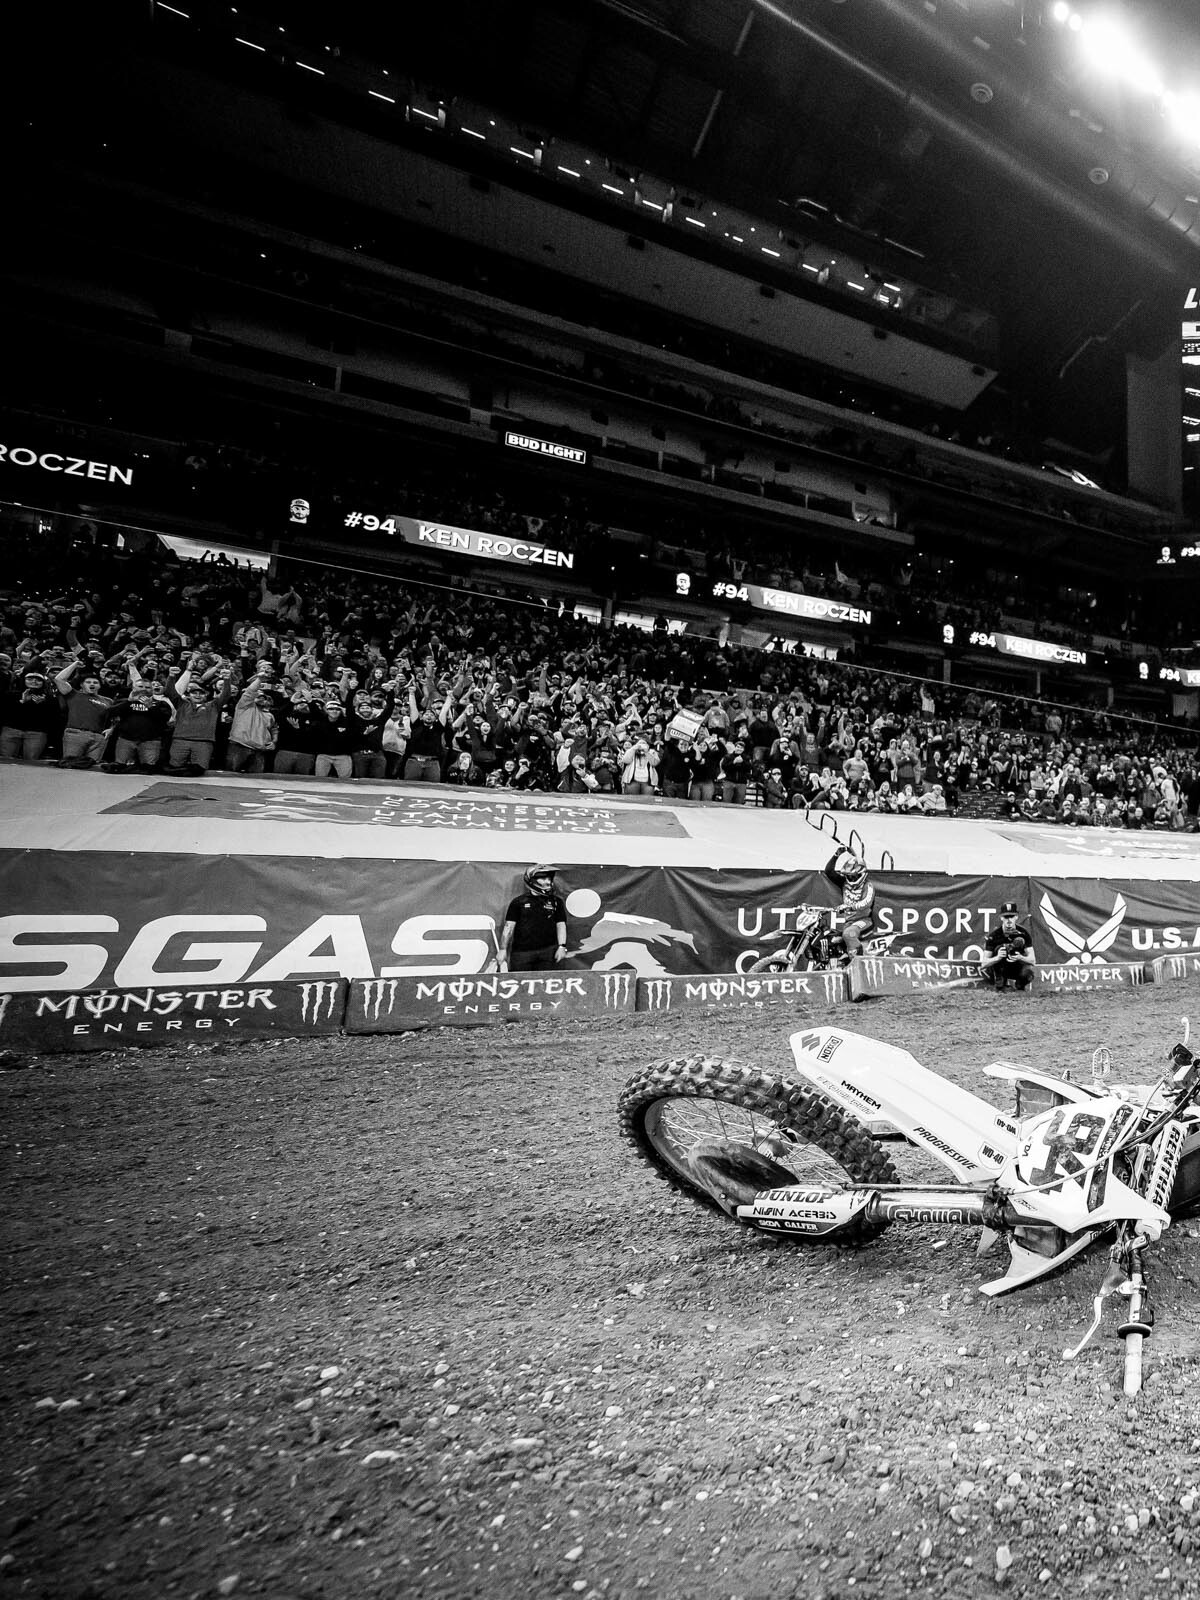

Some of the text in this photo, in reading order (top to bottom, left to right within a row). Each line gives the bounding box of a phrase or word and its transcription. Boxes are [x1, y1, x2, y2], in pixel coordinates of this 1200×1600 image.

[508, 434, 583, 461] BUD LIGHT
[344, 511, 574, 569] #94 KEN ROCZEN
[712, 582, 872, 625] #94 KEN ROCZEN
[969, 631, 1087, 664] #94 KEN ROCZEN
[1159, 668, 1181, 682] #94
[878, 907, 996, 934] SPORT
[1131, 929, 1190, 950] U.S.
[0, 915, 498, 991] SGAS
[893, 961, 991, 978] MONSTER
[1040, 966, 1124, 983] MONSTER
[415, 977, 587, 1002] MONSTER
[685, 977, 813, 1001] MONSTER
[35, 988, 278, 1019] MONSTER
[443, 1001, 562, 1014] ENERGY
[72, 1018, 241, 1035] ENERGY
[841, 1080, 882, 1110] MAYHEM
[996, 1118, 1017, 1135] WD-40
[913, 1126, 978, 1171] PROGRESSIVE
[982, 1145, 1005, 1165] WD-40
[1152, 1124, 1181, 1207] RENTHA
[754, 1189, 834, 1204] DUNLOP
[752, 1206, 785, 1217] NISSIN
[784, 1221, 819, 1231] GALFER
